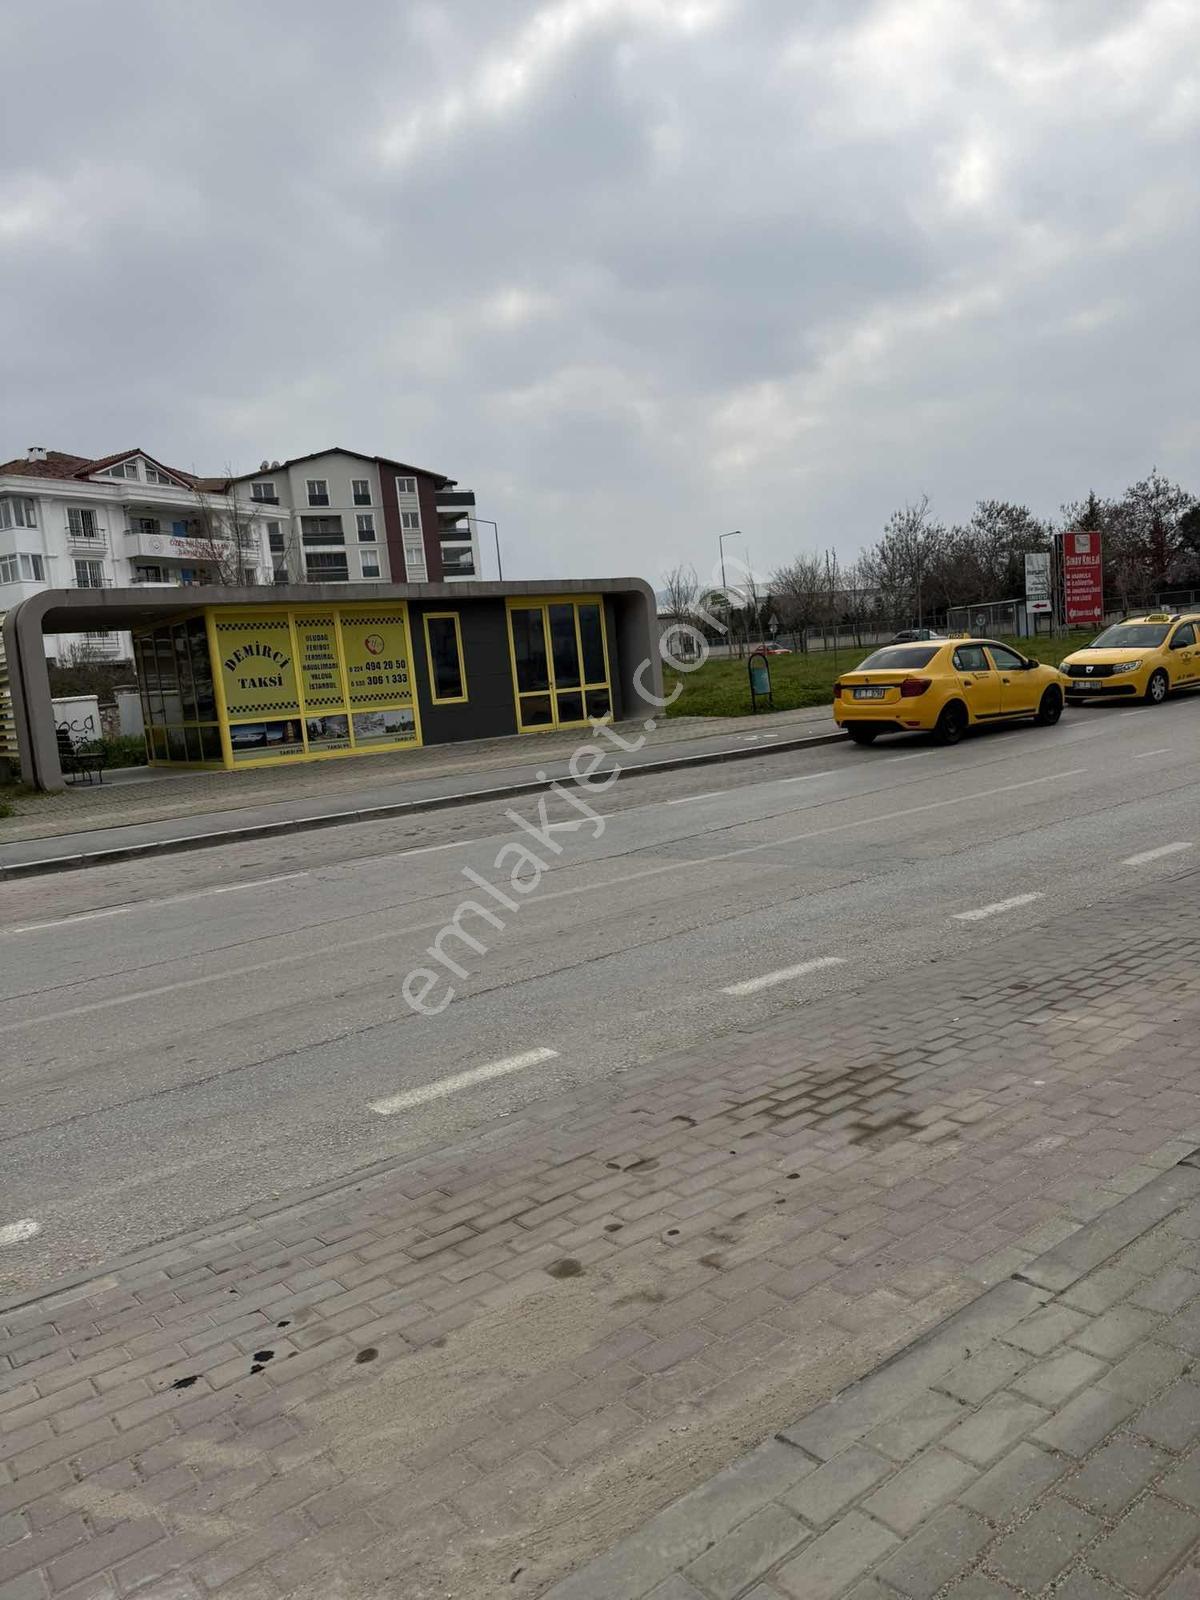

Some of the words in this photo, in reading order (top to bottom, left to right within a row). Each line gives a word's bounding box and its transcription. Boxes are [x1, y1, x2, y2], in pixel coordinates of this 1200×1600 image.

[224, 641, 291, 672] DEMİRCİ
[365, 661, 381, 671] 494
[395, 659, 406, 669] 50
[238, 673, 283, 689] TAKSİ
[392, 673, 408, 684] 333
